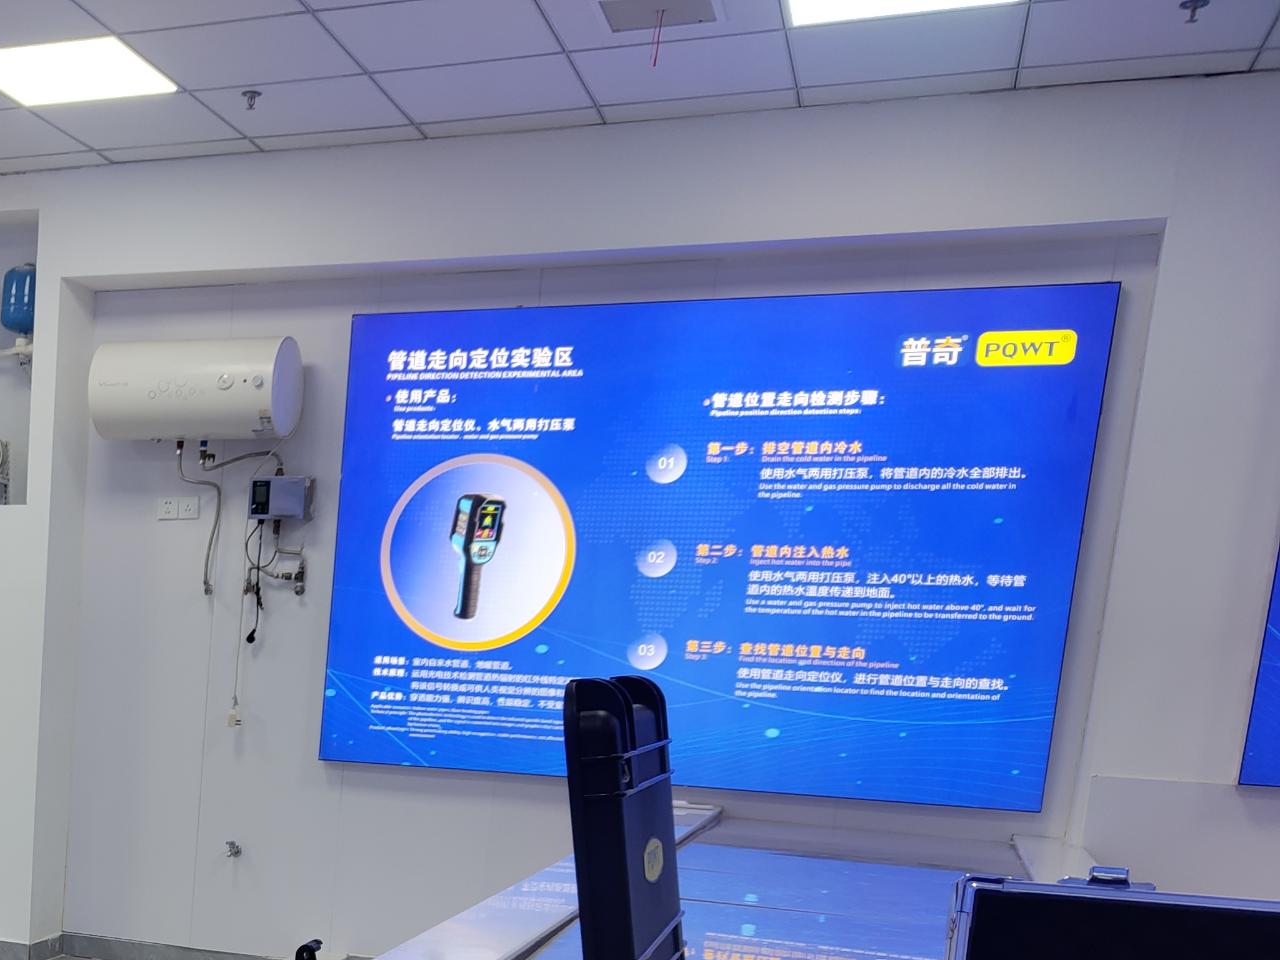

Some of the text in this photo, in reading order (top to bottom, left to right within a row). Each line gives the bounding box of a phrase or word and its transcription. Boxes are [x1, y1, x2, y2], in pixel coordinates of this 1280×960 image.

[900, 337, 963, 366] 普奇
[387, 346, 574, 371] 管道走向定位实验区
[386, 369, 583, 381] PIPELINE DIRECTION DETECTION EXPERIMENTAL AREA
[394, 389, 457, 404] 使用产品：
[711, 390, 885, 408] 管道位置走向检测步骤：
[711, 409, 738, 418] Pipeline
[739, 408, 769, 418] position
[770, 408, 802, 416] direction
[803, 408, 838, 416] detection
[658, 457, 674, 469] 01
[705, 456, 721, 464] Step
[856, 456, 887, 464] pipeline
[759, 467, 1027, 480] 使用水气两用打压泵，将管道内的冷水全部排出。
[903, 483, 940, 492] discharge
[648, 551, 665, 564] 02
[695, 557, 711, 565] Step
[746, 584, 895, 599] 道内的热水温度传递到地面。
[766, 599, 788, 607] water
[803, 601, 817, 609] gas
[851, 602, 873, 610] pump
[884, 602, 906, 611] inject
[945, 603, 970, 611] above
[758, 607, 802, 616] temperature
[882, 610, 914, 619] pipeline
[935, 611, 978, 619] transferred
[638, 644, 656, 656] 03
[768, 656, 797, 664] location
[812, 659, 846, 667] direction
[868, 661, 899, 671] pipeline
[736, 668, 1009, 690] 使用管道走向定位仪，进行管道位置与走向的查找。
[762, 683, 791, 692] pipeline
[792, 684, 833, 693] orientation
[833, 686, 859, 694] locator
[899, 689, 930, 697] location
[947, 692, 991, 700] orientation
